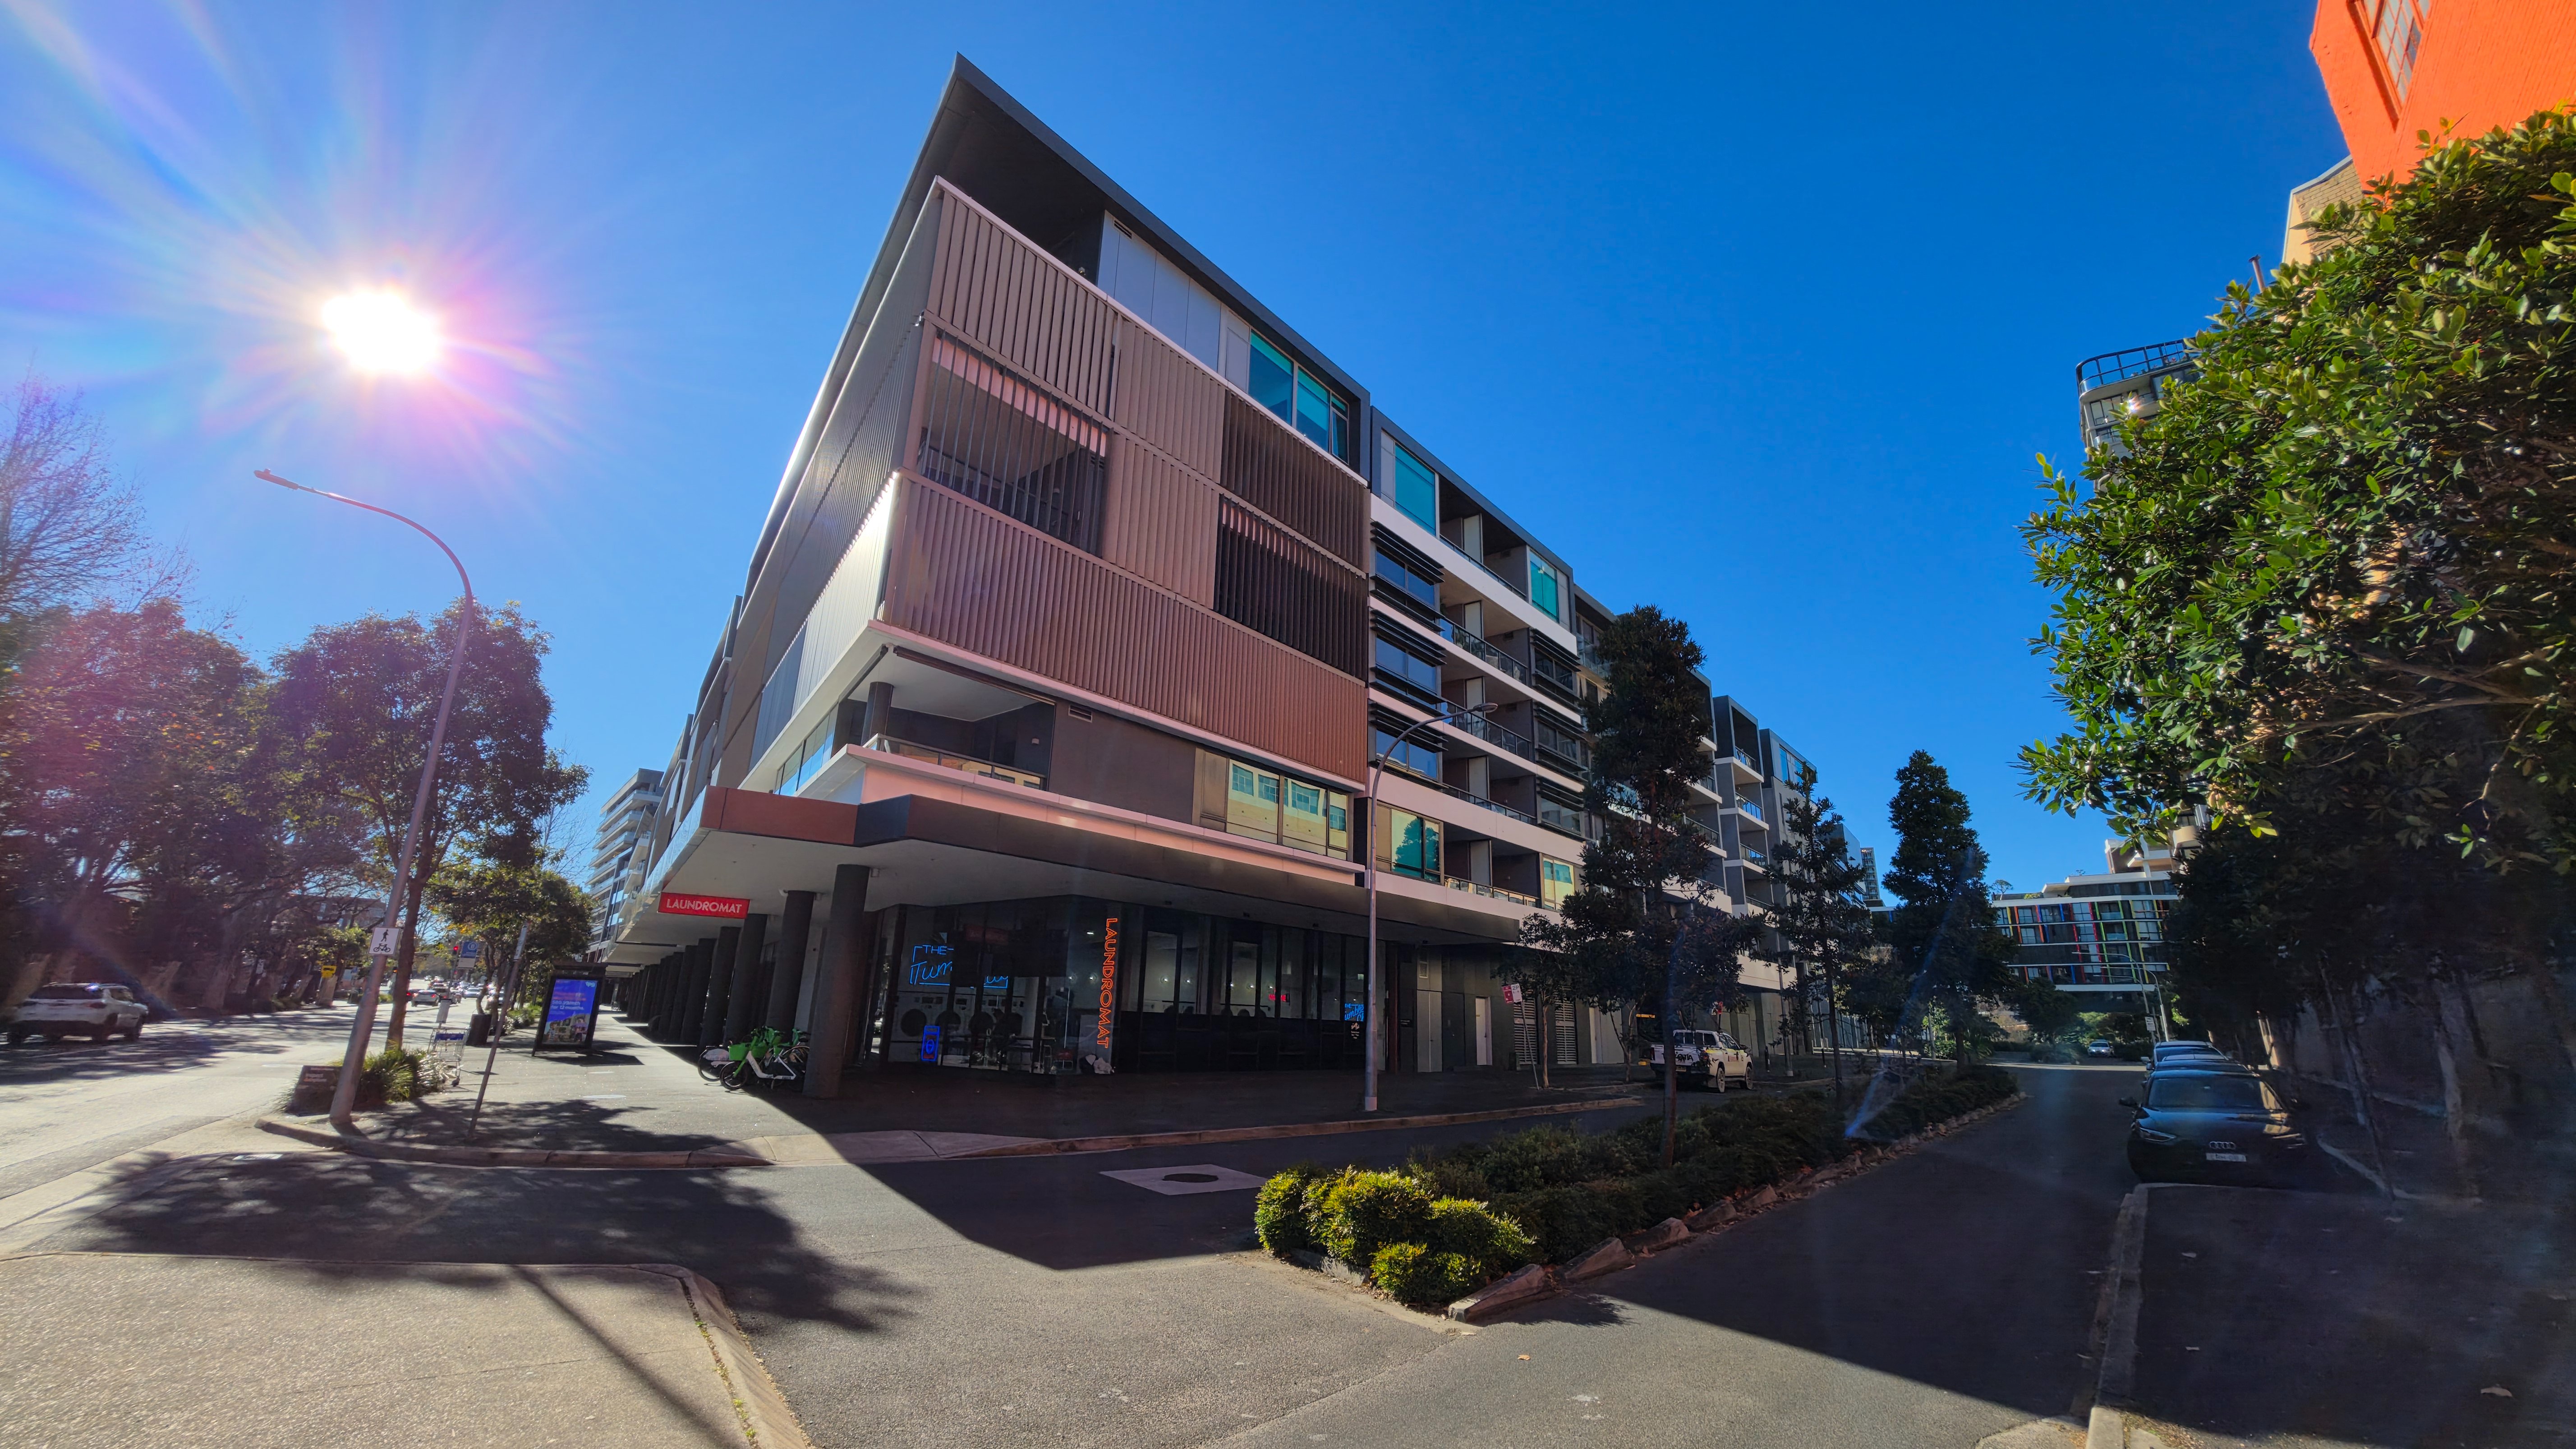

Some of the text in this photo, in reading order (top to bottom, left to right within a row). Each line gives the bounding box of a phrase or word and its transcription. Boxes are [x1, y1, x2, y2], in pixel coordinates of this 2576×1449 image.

[667, 899, 742, 913] LAUNDROMAT
[922, 945, 947, 955] THE
[1097, 918, 1118, 1049] LAUNDROMAT
